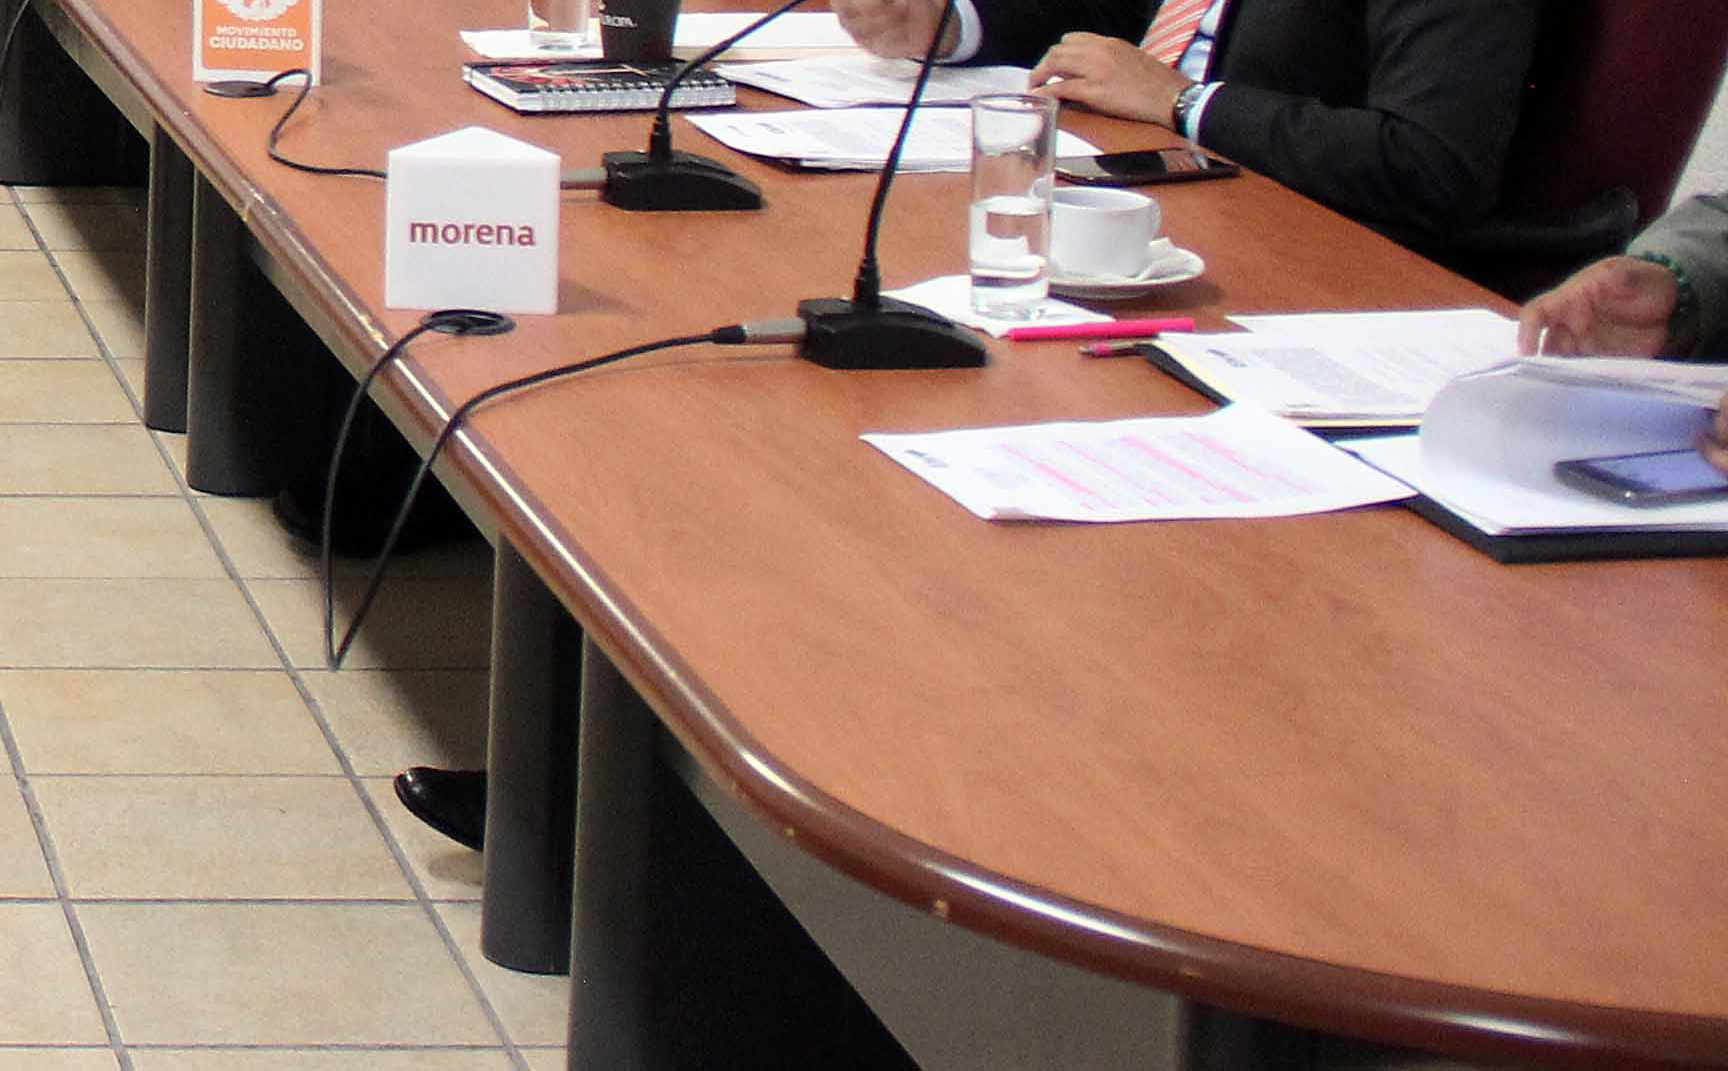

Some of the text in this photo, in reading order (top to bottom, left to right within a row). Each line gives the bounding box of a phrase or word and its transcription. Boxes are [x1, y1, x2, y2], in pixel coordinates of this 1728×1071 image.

[216, 25, 297, 37] MOVIMIENTO
[209, 36, 304, 51] CIUDADANO
[409, 221, 537, 247] morena
